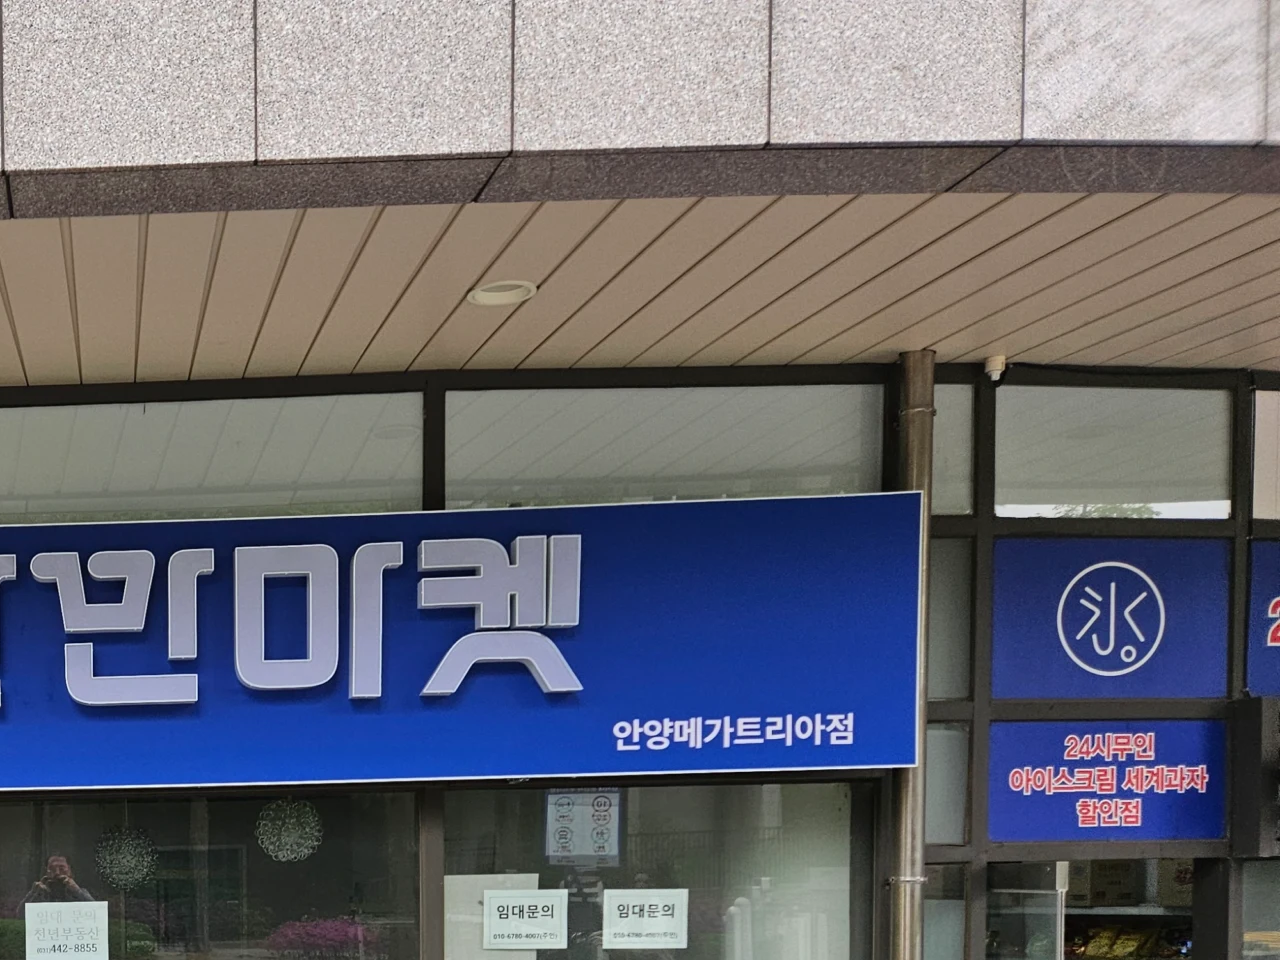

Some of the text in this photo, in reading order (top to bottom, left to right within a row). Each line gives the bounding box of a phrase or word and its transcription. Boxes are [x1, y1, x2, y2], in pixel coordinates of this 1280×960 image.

[612, 712, 855, 752] 안양메가트리아점
[1064, 733, 1155, 760] 24시무인
[1009, 765, 1208, 795] 아이스크림 세계과자
[1076, 799, 1142, 827] 할인점
[497, 904, 554, 919] 임대문의
[617, 903, 675, 918] 임대문의
[34, 926, 100, 941] 천년부동산
